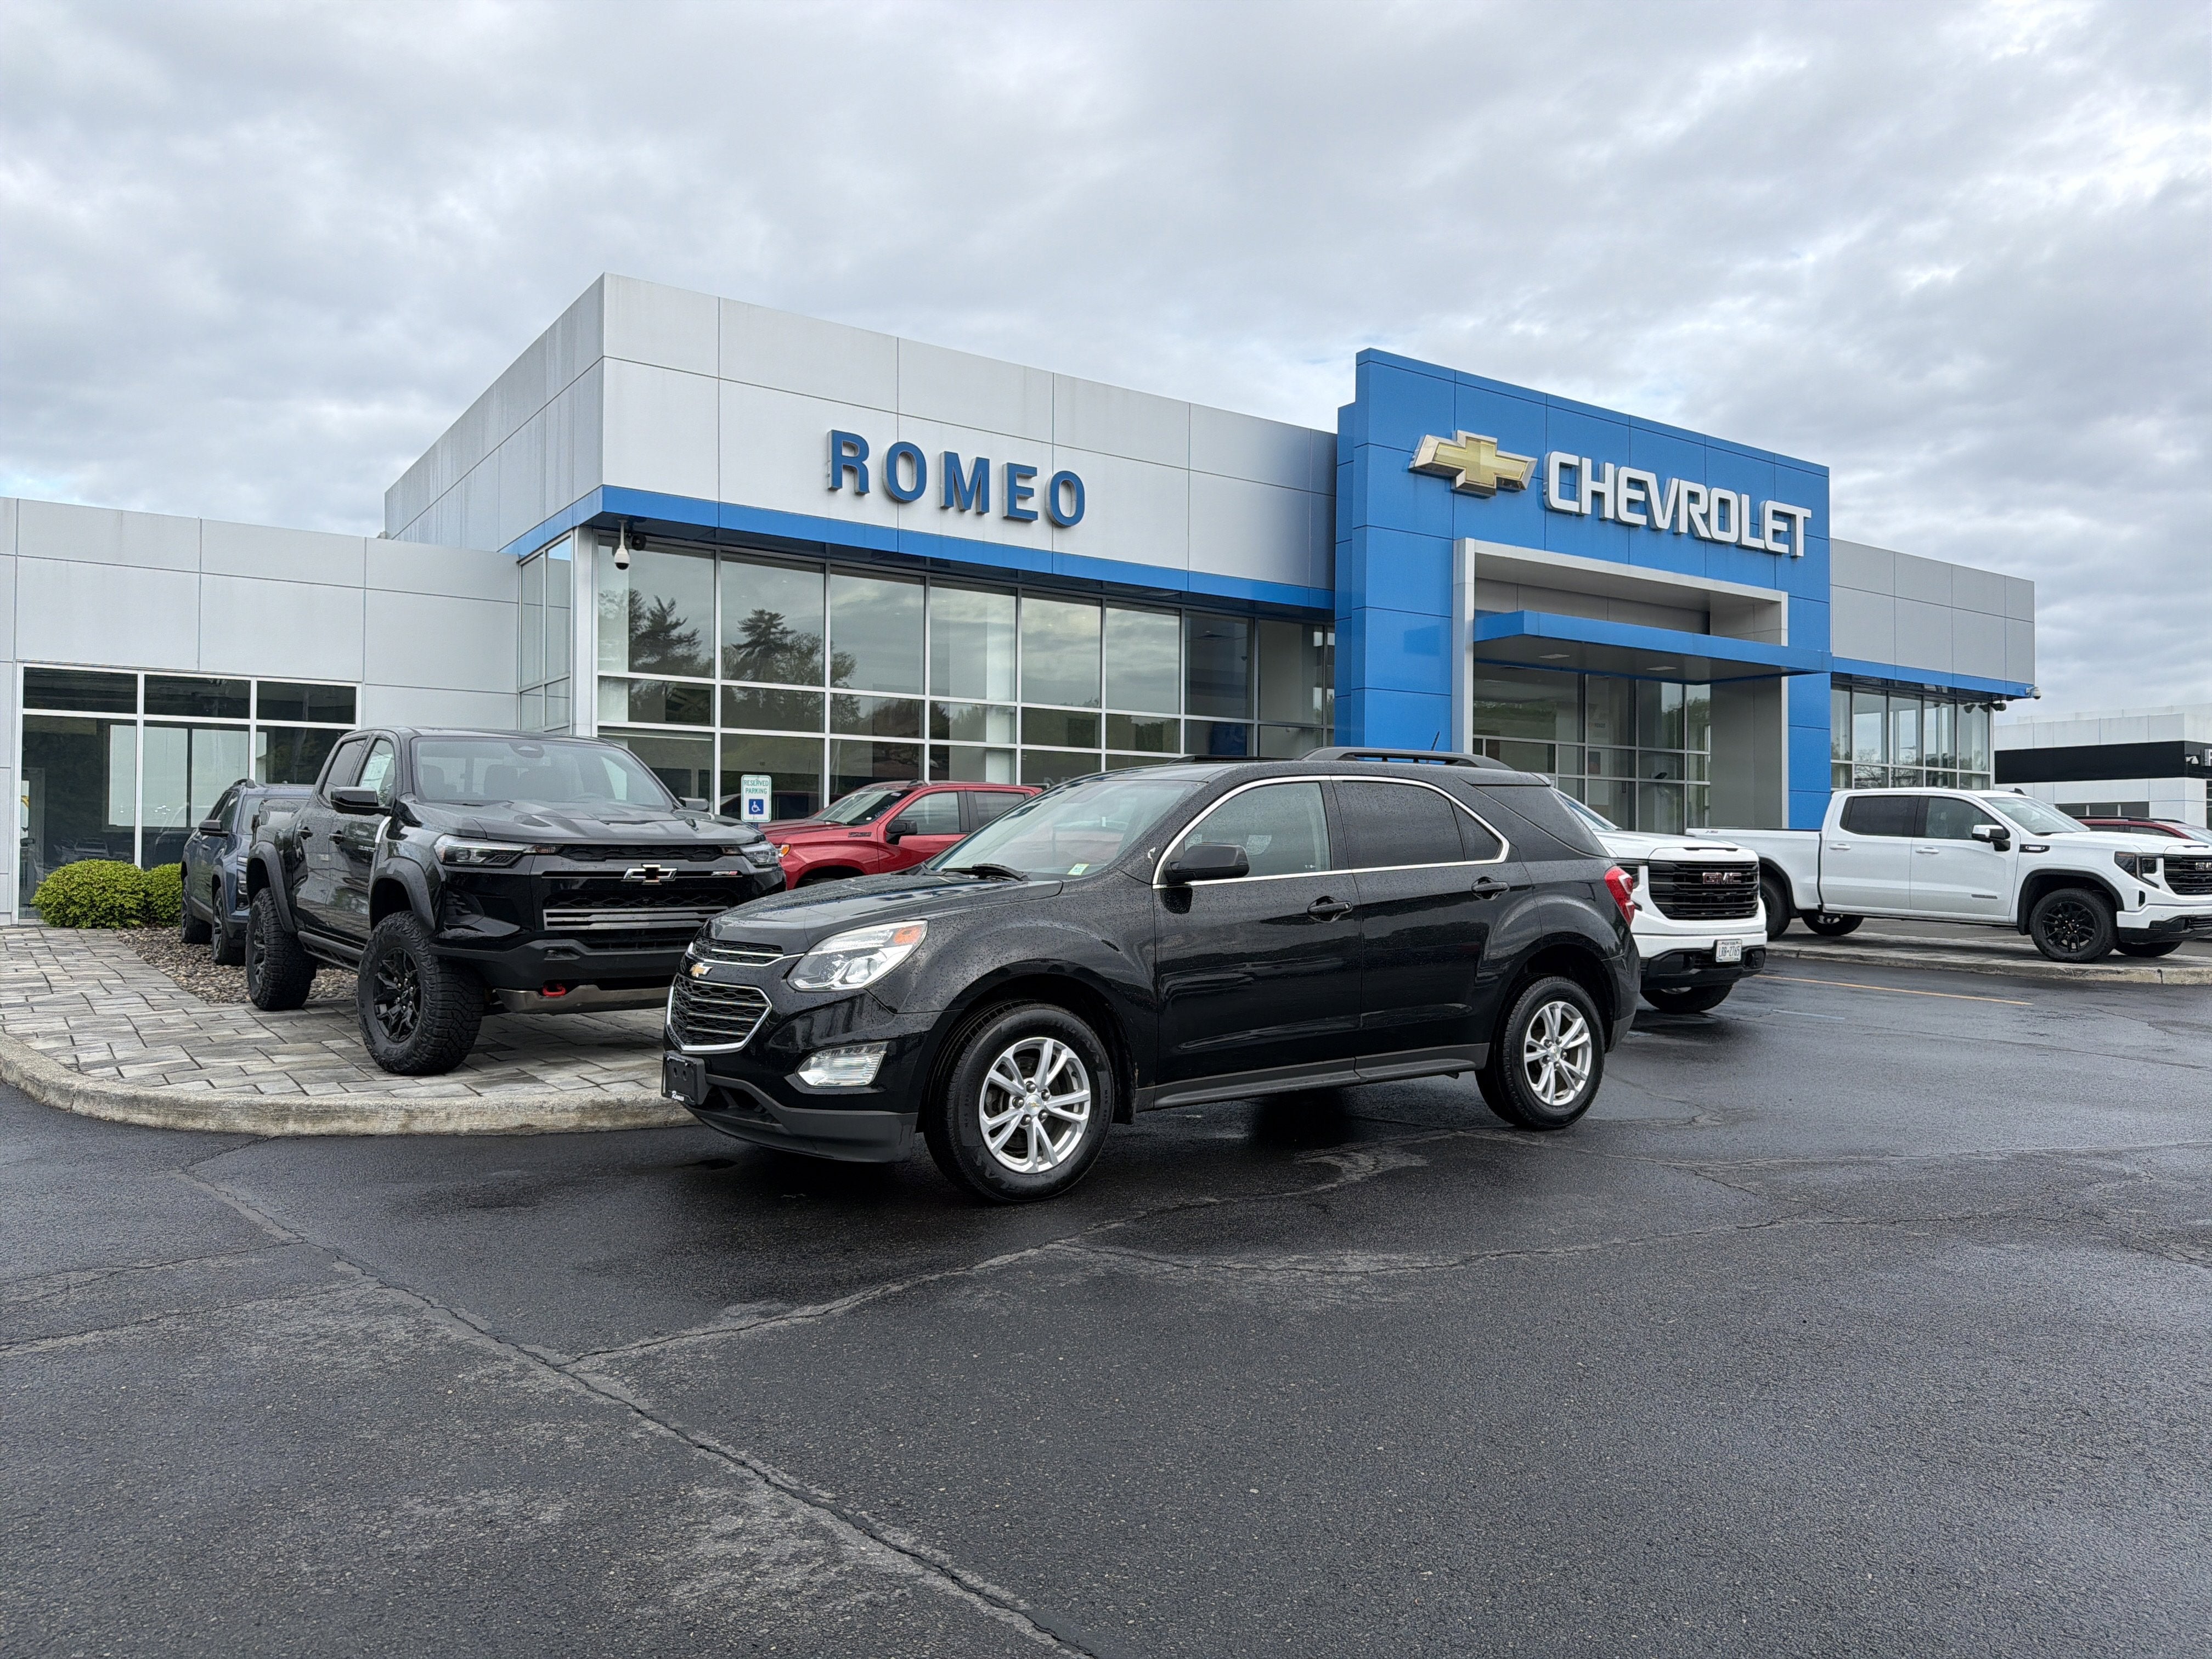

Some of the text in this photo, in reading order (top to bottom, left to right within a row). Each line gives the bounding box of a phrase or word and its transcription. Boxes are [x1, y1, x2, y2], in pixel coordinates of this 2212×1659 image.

[827, 429, 1086, 528] ROMEO
[1543, 451, 1812, 558] CHEVROLET
[1702, 872, 1742, 884] GMC
